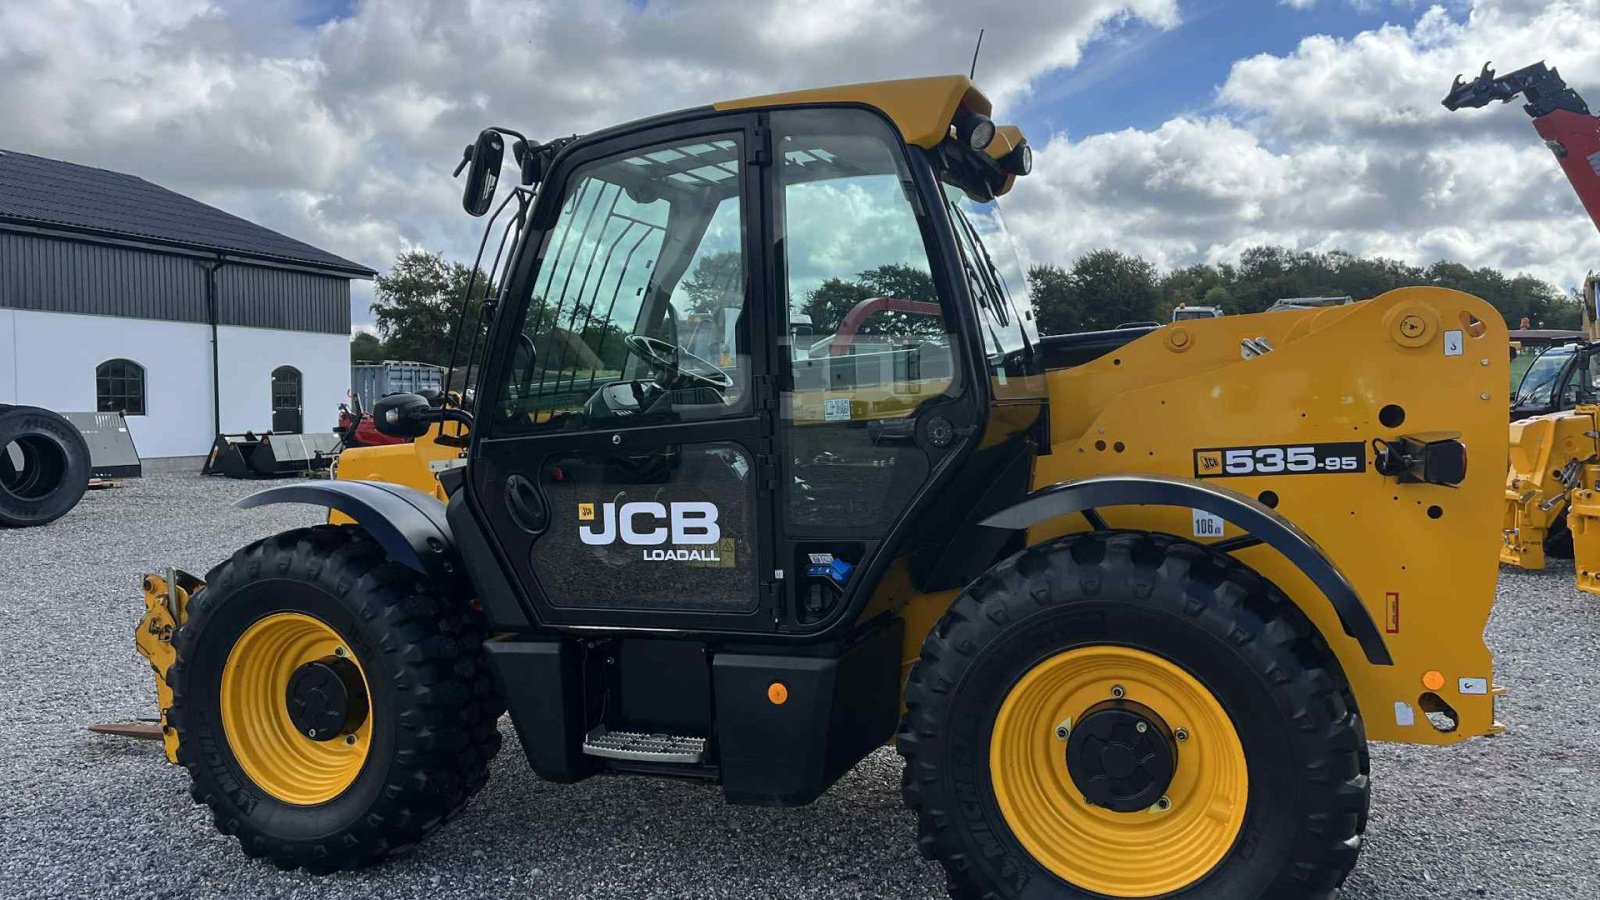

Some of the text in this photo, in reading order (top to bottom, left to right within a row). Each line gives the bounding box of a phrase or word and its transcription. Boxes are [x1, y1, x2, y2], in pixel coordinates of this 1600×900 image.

[1225, 446, 1358, 474] 535-95
[579, 501, 721, 545] JCB
[1195, 518, 1213, 534] 106
[643, 549, 721, 561] LOADALL
